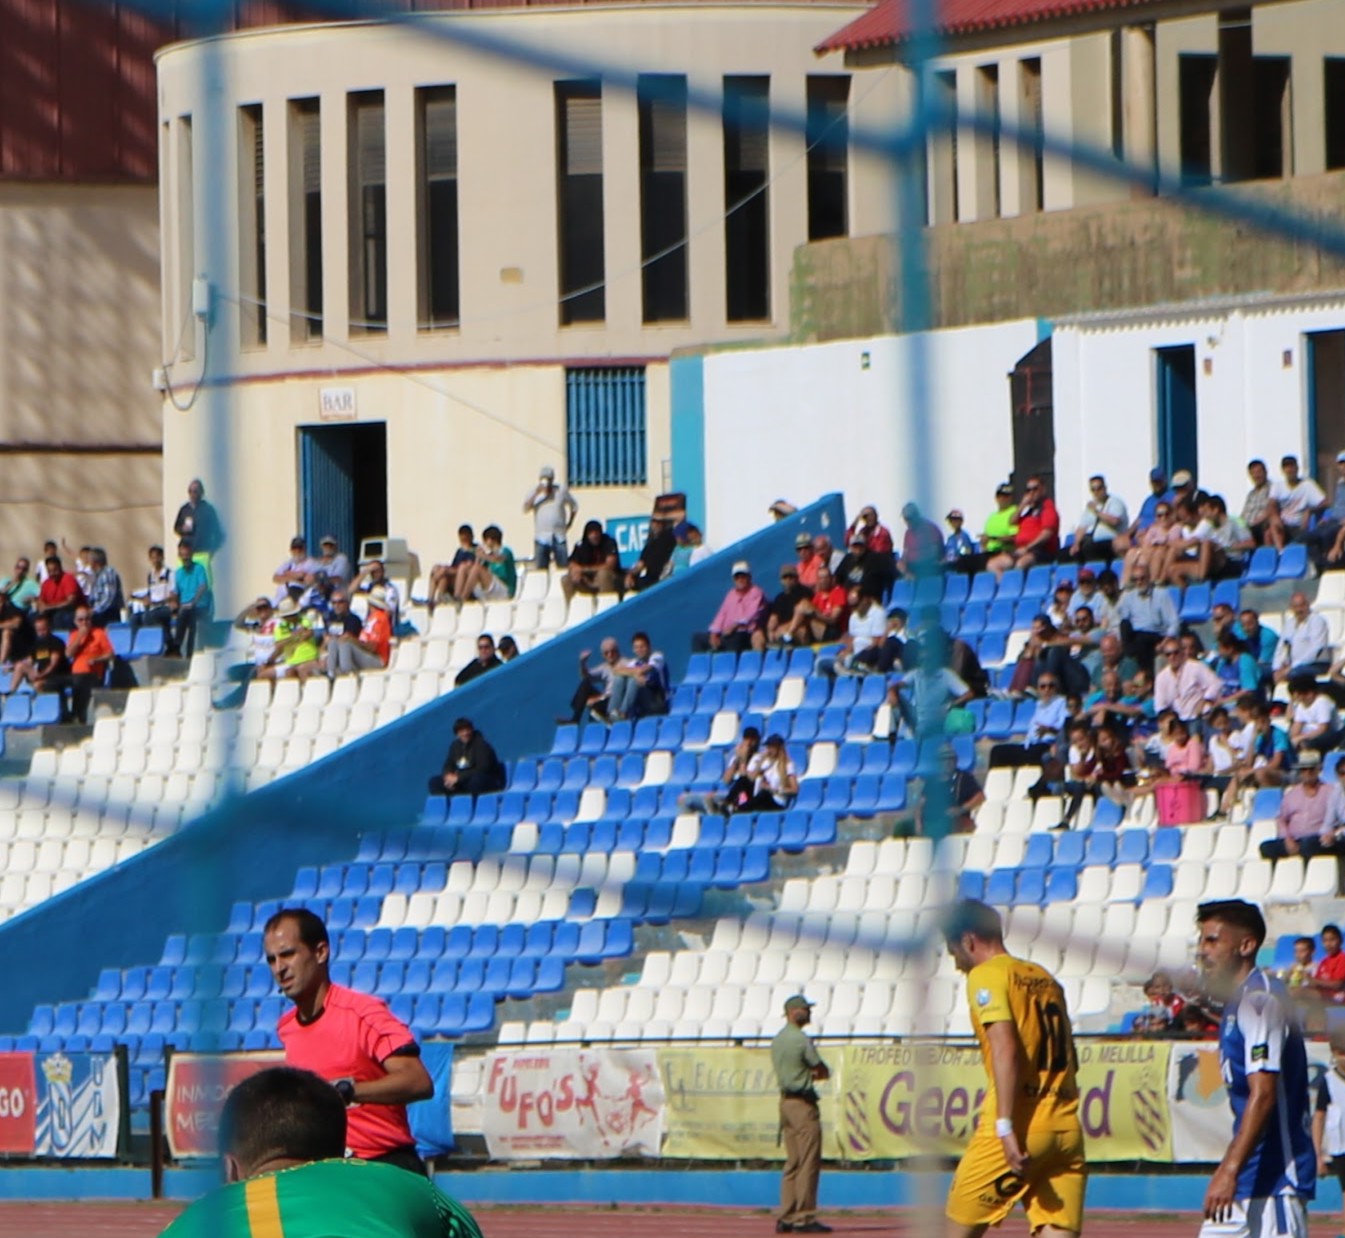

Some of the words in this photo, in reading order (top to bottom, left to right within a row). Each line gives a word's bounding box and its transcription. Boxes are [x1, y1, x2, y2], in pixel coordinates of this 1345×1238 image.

[323, 393, 352, 411] BAR
[861, 1048, 912, 1066] TROFEO
[916, 1048, 963, 1066] EJOR
[1099, 1045, 1155, 1063] MELILLA
